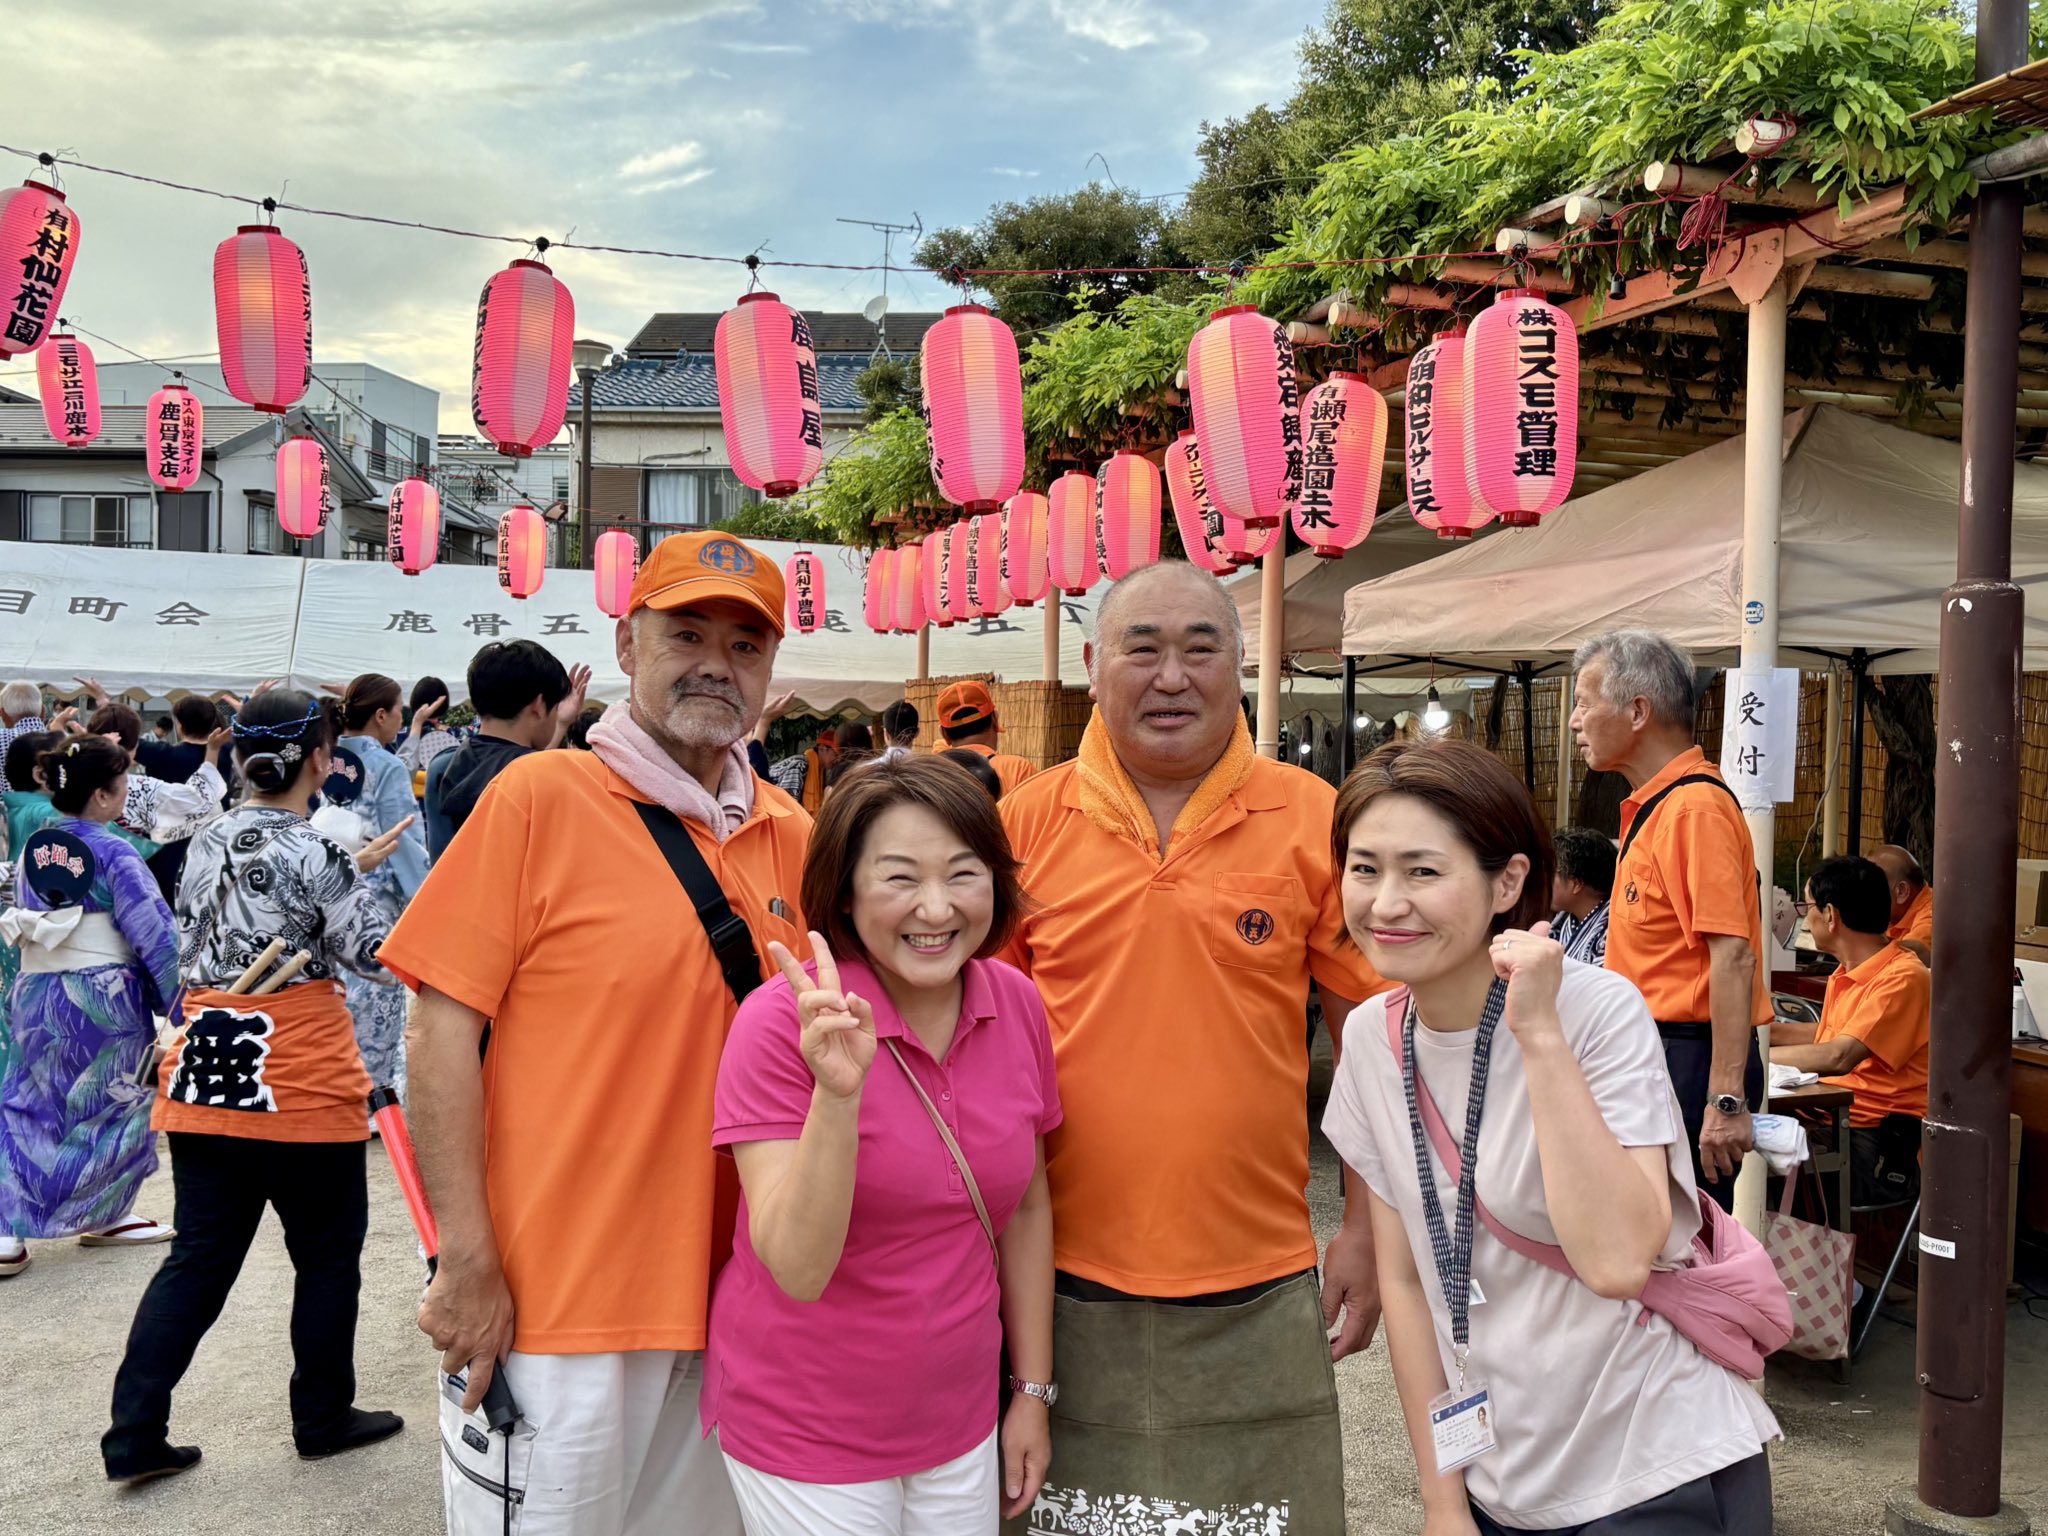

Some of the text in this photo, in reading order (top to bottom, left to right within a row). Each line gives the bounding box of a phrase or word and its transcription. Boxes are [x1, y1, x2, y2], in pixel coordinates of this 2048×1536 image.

[158, 401, 181, 478] 鹿骨支店
[1737, 691, 1766, 776] 受付
